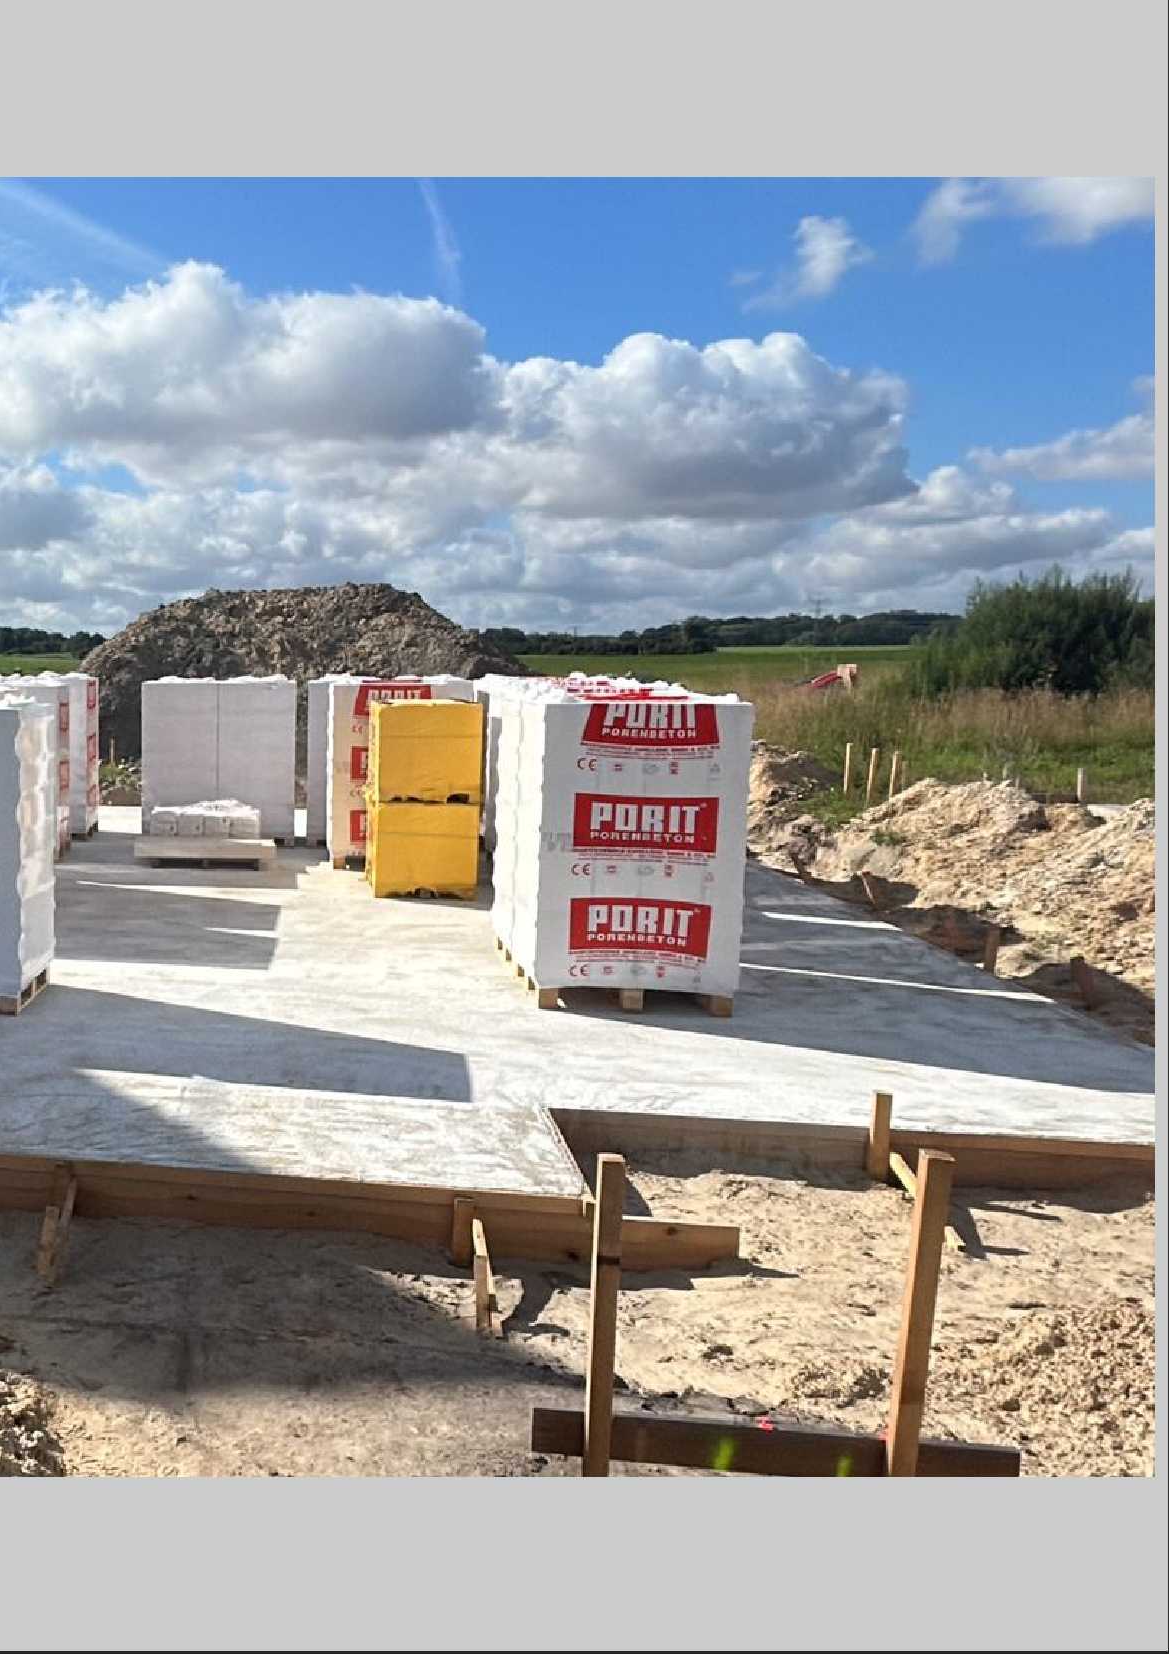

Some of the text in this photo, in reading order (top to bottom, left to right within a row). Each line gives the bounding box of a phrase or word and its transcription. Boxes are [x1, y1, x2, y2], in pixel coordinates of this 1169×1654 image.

[603, 704, 697, 729] PORIT
[601, 727, 697, 739] PORENBETON
[590, 800, 700, 834] PORIT
[590, 831, 696, 844] PORENBETON
[587, 904, 694, 937] PORIT
[586, 933, 688, 947] PORENBETON
